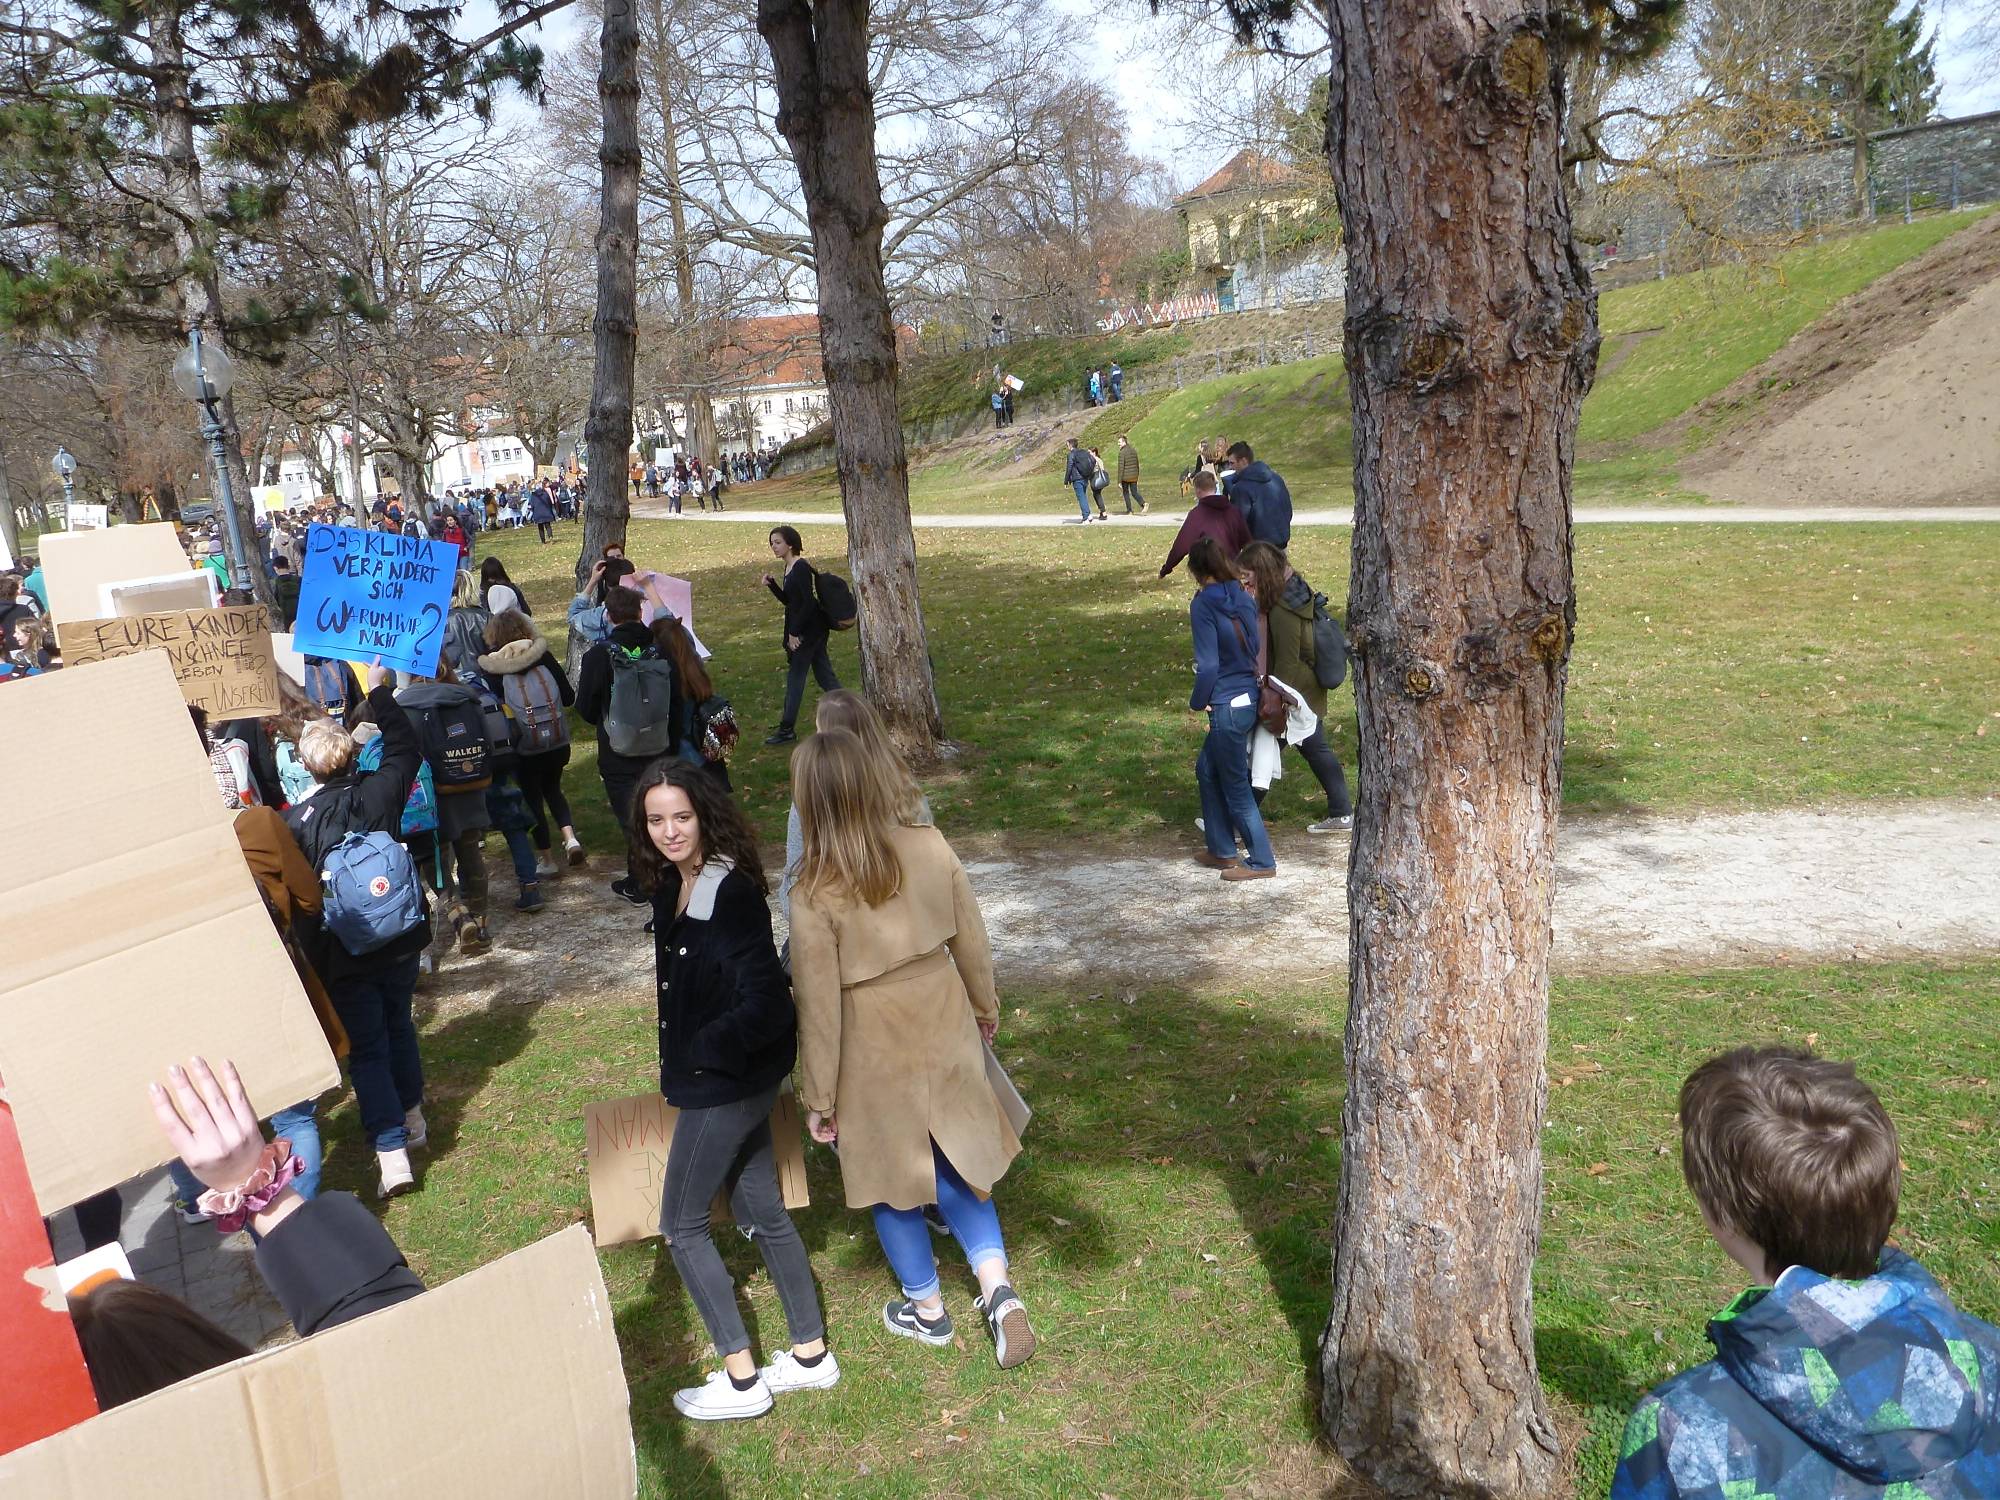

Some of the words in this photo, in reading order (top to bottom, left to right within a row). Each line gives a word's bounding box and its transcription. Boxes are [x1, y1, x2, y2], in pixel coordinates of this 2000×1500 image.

[364, 533, 434, 562] KLIMA
[332, 553, 440, 584] VERÄNDERT
[368, 580, 404, 600] SICH
[94, 617, 180, 653] EURE
[186, 606, 270, 641] KINDER
[316, 597, 393, 634] WARUM
[395, 613, 422, 635] WIR
[185, 638, 253, 667] SCHNEE
[358, 629, 401, 648] NICHT
[213, 677, 276, 712] UNSEREN
[445, 746, 482, 758] WALKER
